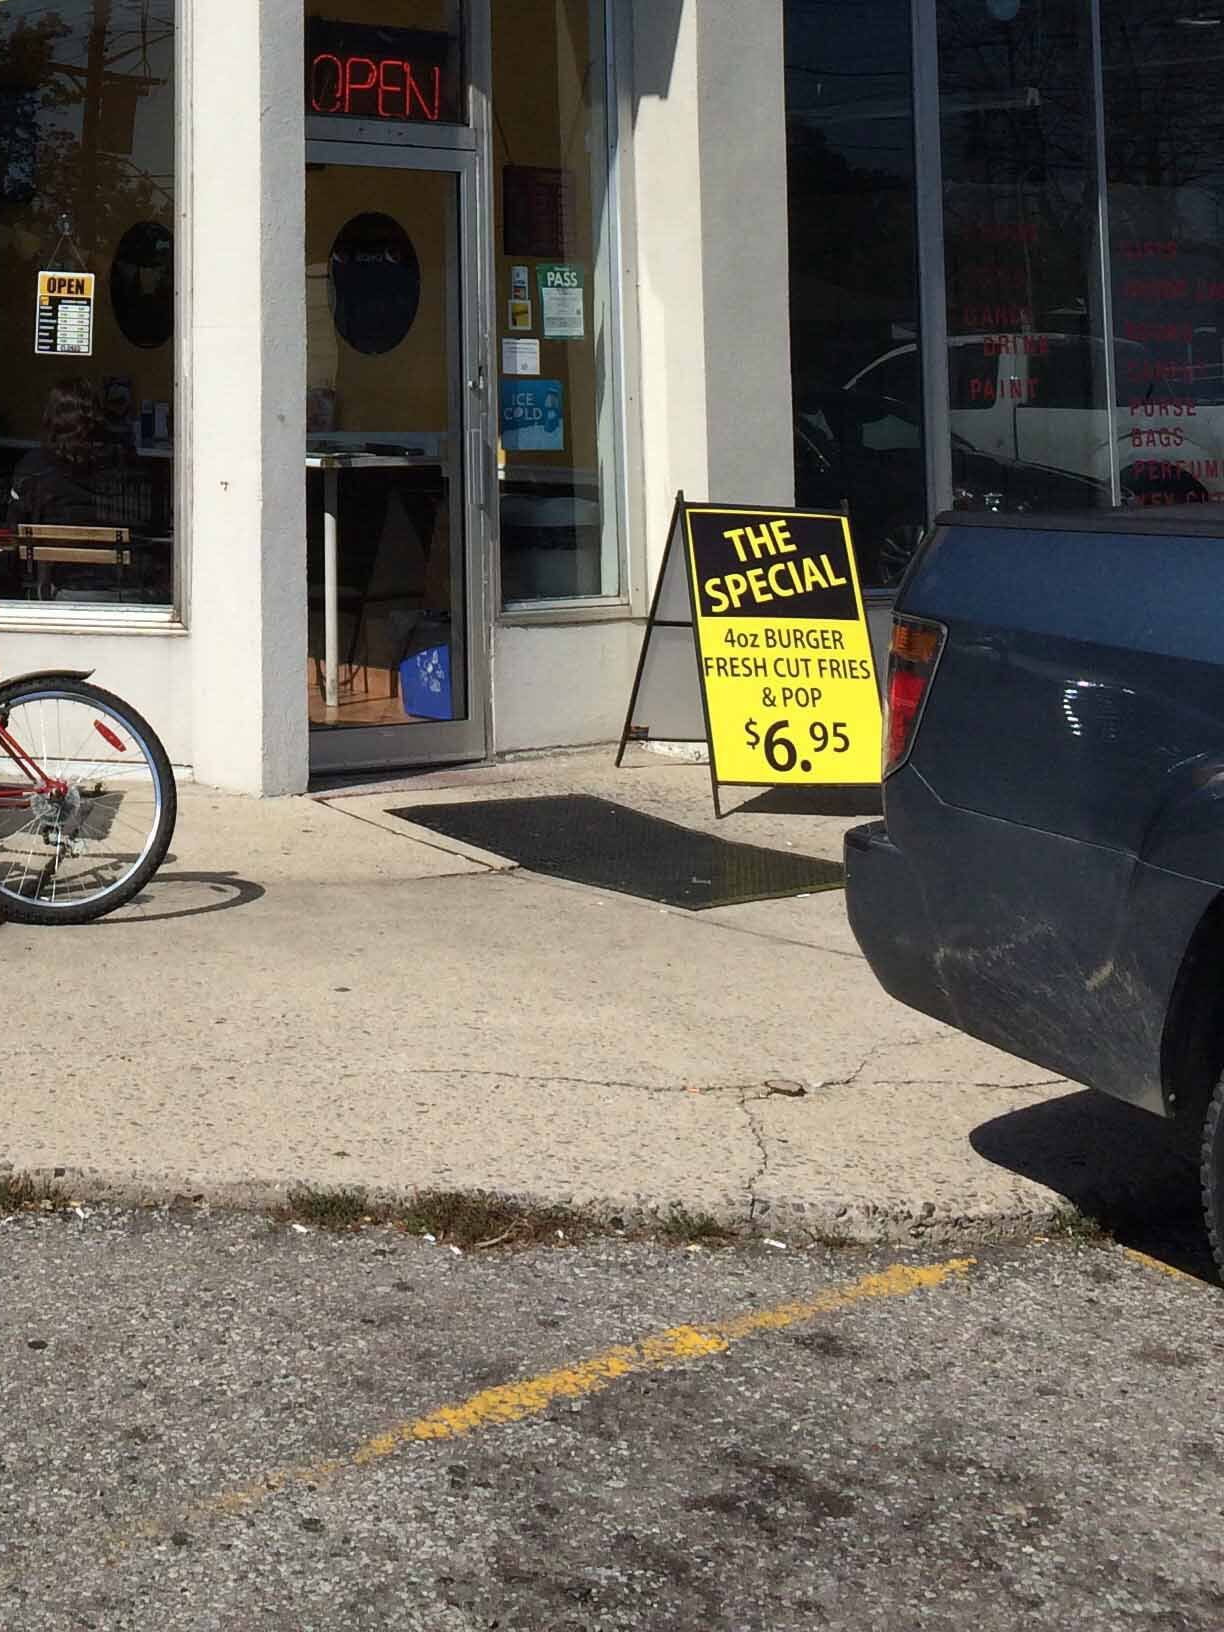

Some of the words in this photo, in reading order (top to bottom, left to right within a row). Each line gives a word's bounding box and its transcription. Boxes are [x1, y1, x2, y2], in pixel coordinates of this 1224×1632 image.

[311, 52, 441, 121] OPEN
[46, 277, 86, 295] OPEN
[546, 271, 579, 288] PASS
[511, 392, 537, 407] ICE
[1129, 399, 1197, 418] PURSE
[503, 406, 544, 421] COLD
[1131, 426, 1185, 448] BAGS
[1132, 459, 1224, 481] PERFUM
[722, 519, 798, 563] THE
[704, 553, 847, 613] SPECIAL
[723, 627, 760, 649] 4oz
[765, 626, 845, 651] BURGER
[704, 656, 768, 678] FRESH
[773, 657, 812, 679] CUT
[818, 658, 871, 680] FRIES
[761, 686, 777, 708] &
[782, 687, 823, 709] POP
[744, 717, 851, 773] $6.95
